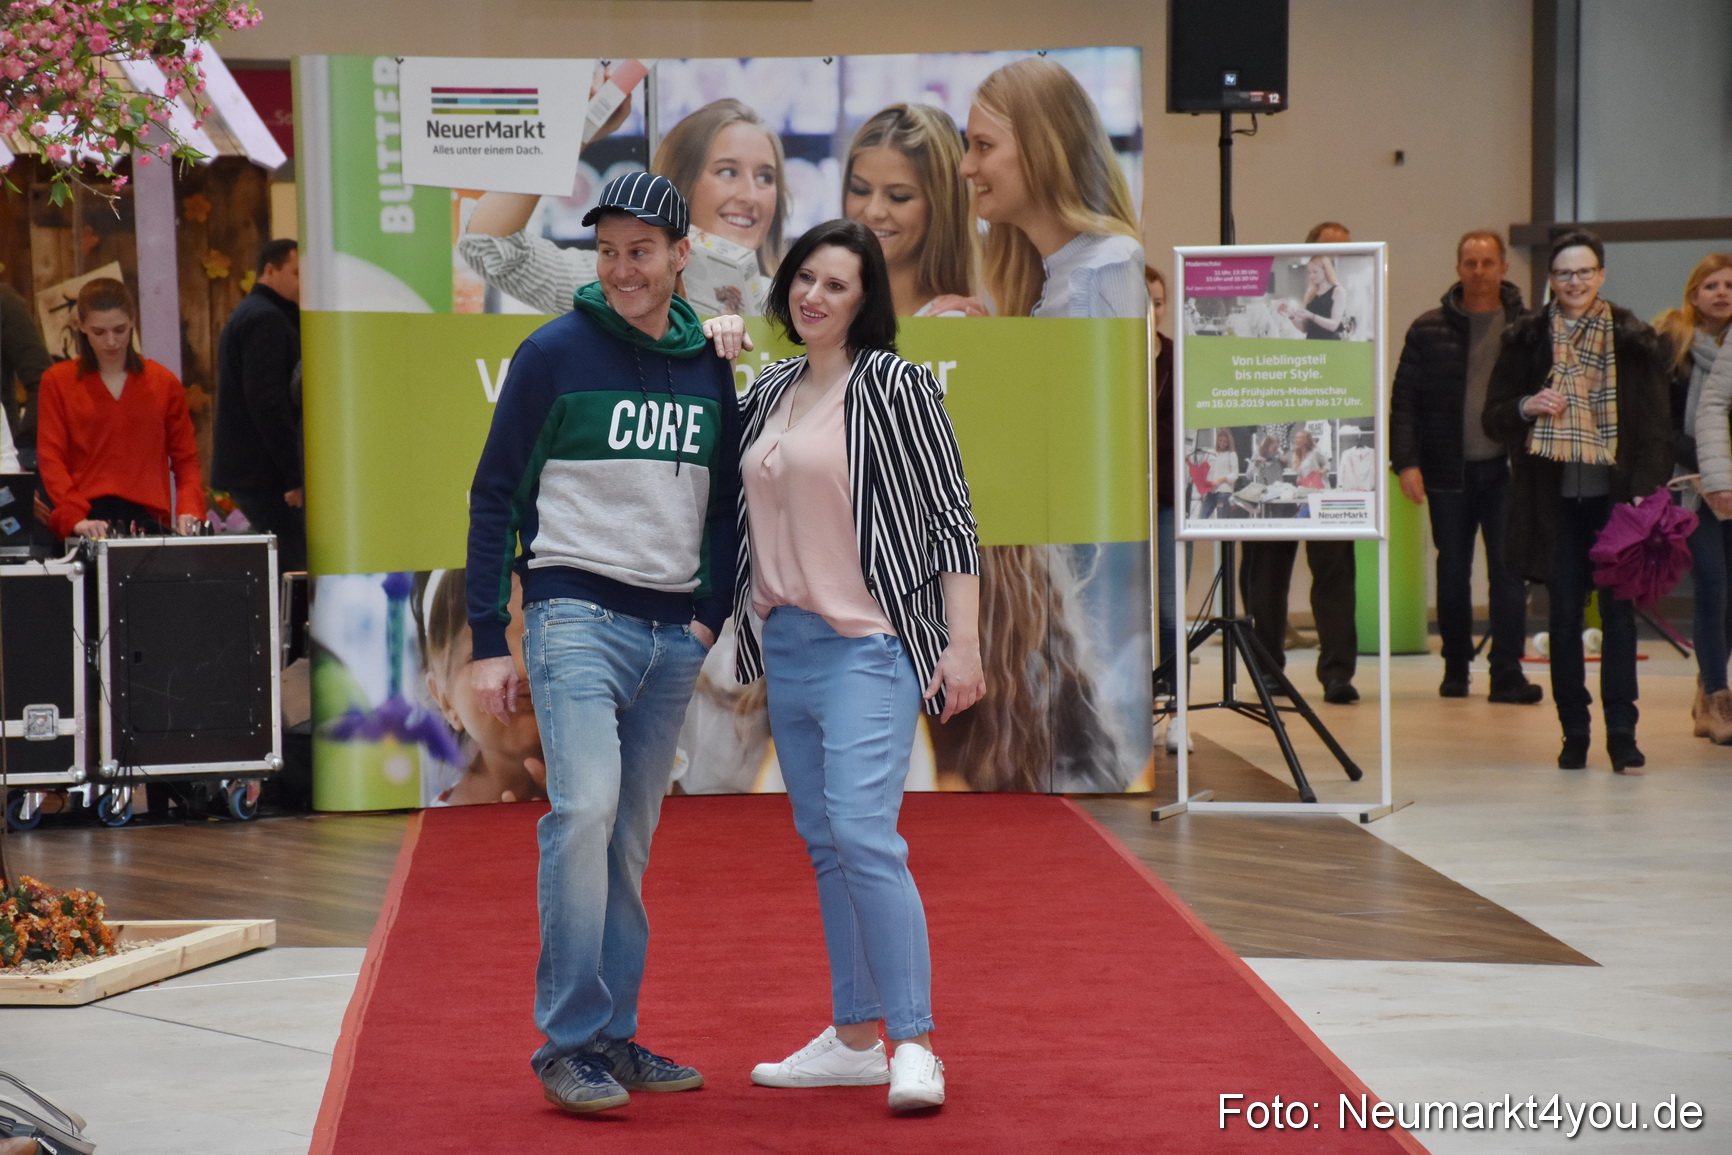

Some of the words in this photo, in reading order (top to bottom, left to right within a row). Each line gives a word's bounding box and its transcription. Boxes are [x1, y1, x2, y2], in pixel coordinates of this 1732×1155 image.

[1268, 93, 1280, 103] 12
[426, 120, 546, 139] NeuerMarkt
[432, 145, 455, 155] Alles
[456, 146, 481, 155] unter
[484, 146, 512, 155] einem
[516, 146, 543, 155] Dach.
[1231, 355, 1253, 366] Von
[1256, 354, 1327, 367] Lieblingsteil
[1235, 369, 1251, 380] bis
[1254, 370, 1287, 380] neuer
[1290, 368, 1323, 381] Style.
[1212, 388, 1239, 397] Große
[1241, 386, 1347, 398] Frühjahrs-Modenschau
[1212, 399, 1264, 408] 16.03.2019
[1284, 398, 1295, 407] 11
[1297, 398, 1314, 406] Uhr
[1315, 397, 1329, 407] bis
[1330, 398, 1342, 406] 17
[1344, 397, 1363, 406] Uhr.
[608, 399, 704, 454] CORE
[1318, 511, 1368, 519] NeuerMarkt
